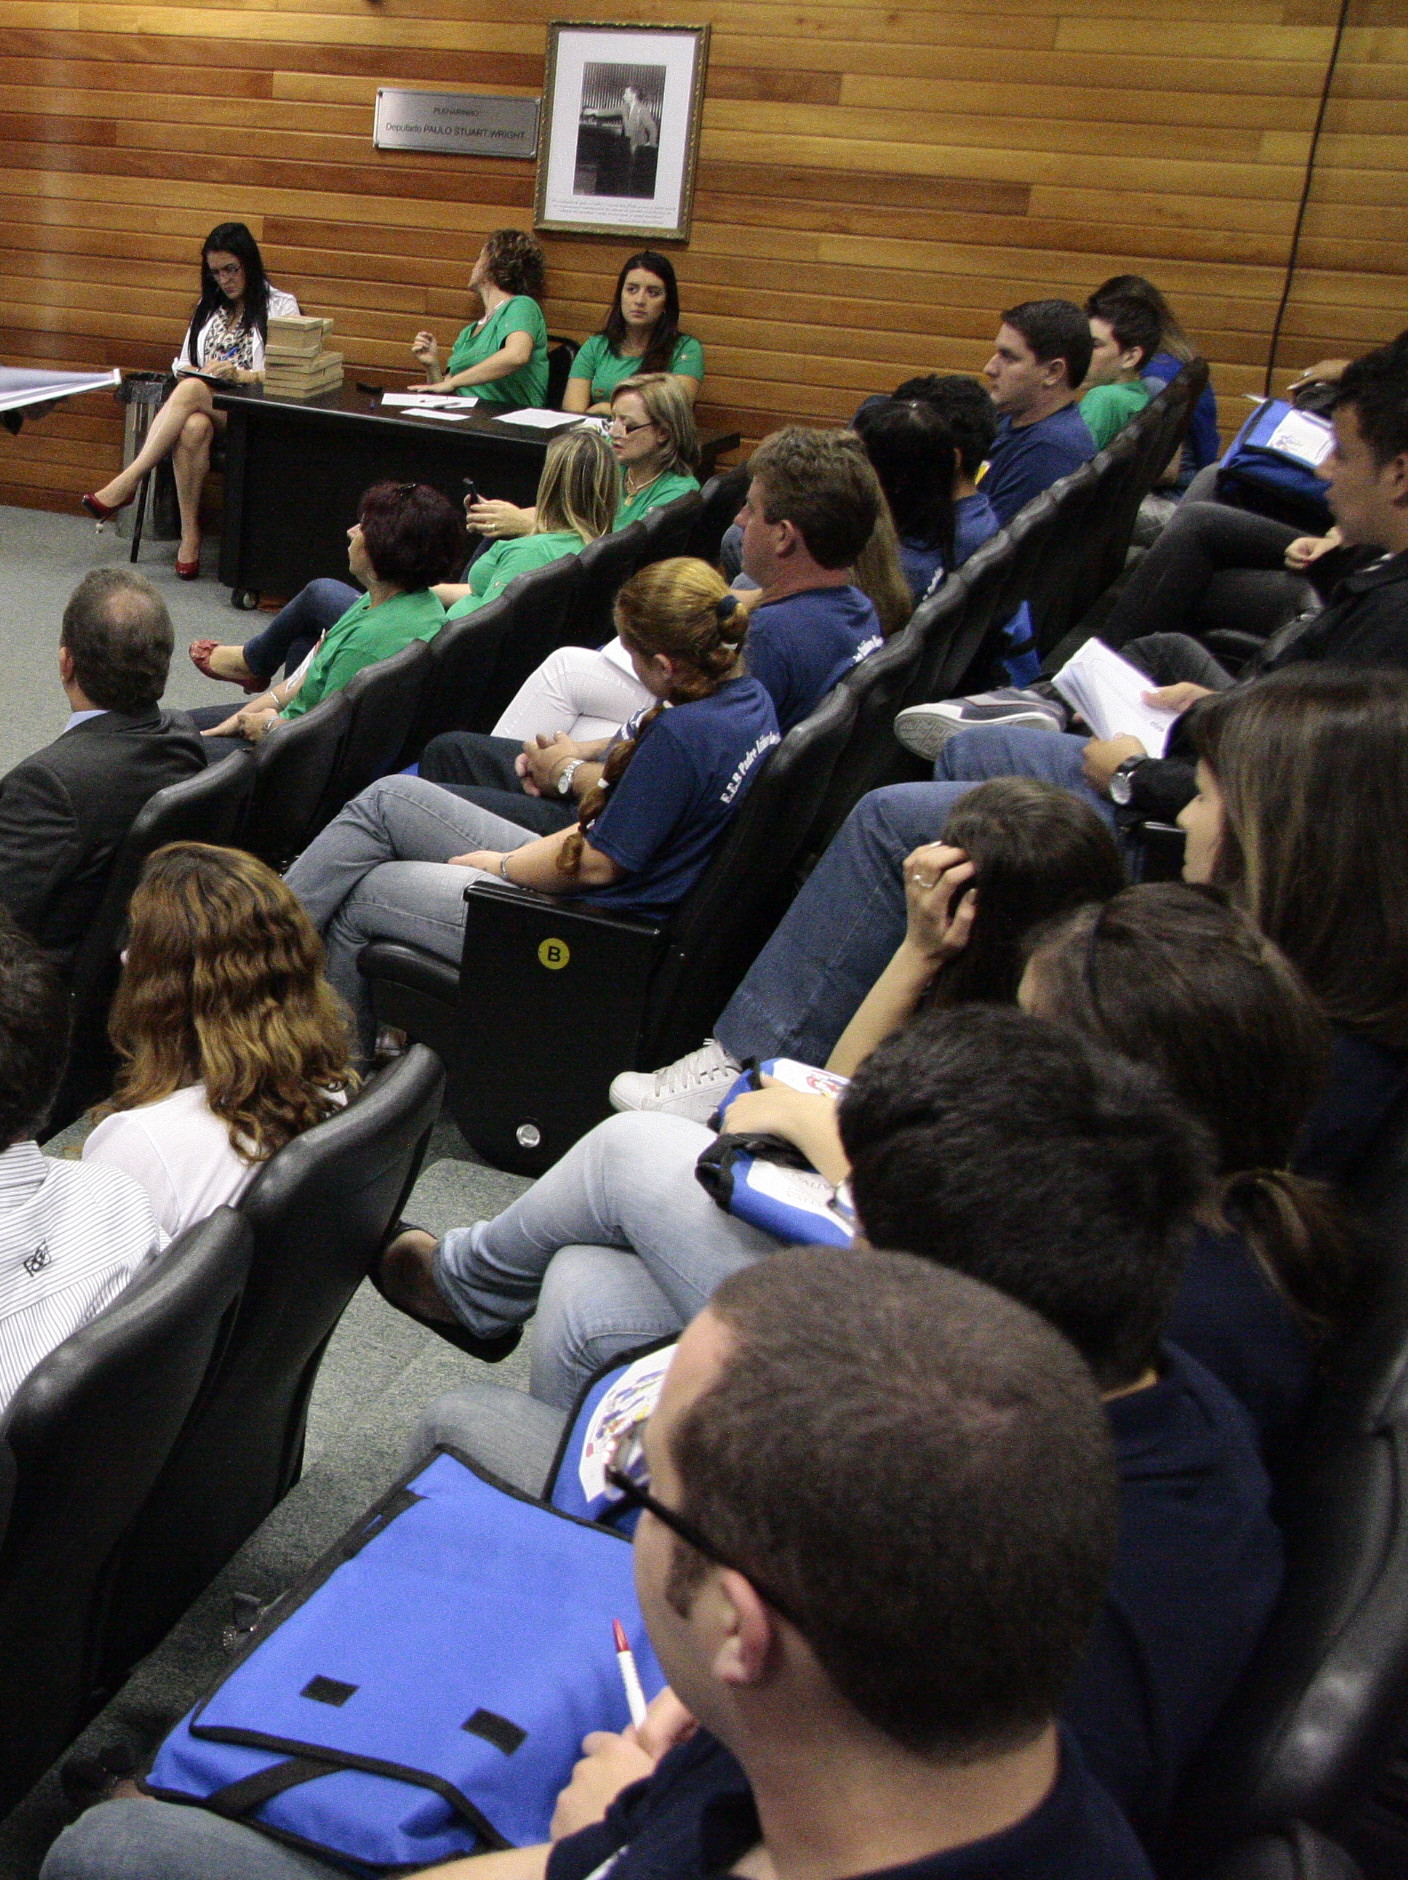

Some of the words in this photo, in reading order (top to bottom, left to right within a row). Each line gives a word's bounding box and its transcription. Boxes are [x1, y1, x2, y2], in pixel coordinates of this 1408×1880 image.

[423, 126, 452, 135] PAULO
[454, 127, 487, 137] STUART
[490, 130, 526, 140] WRIGHT
[547, 946, 561, 962] B
